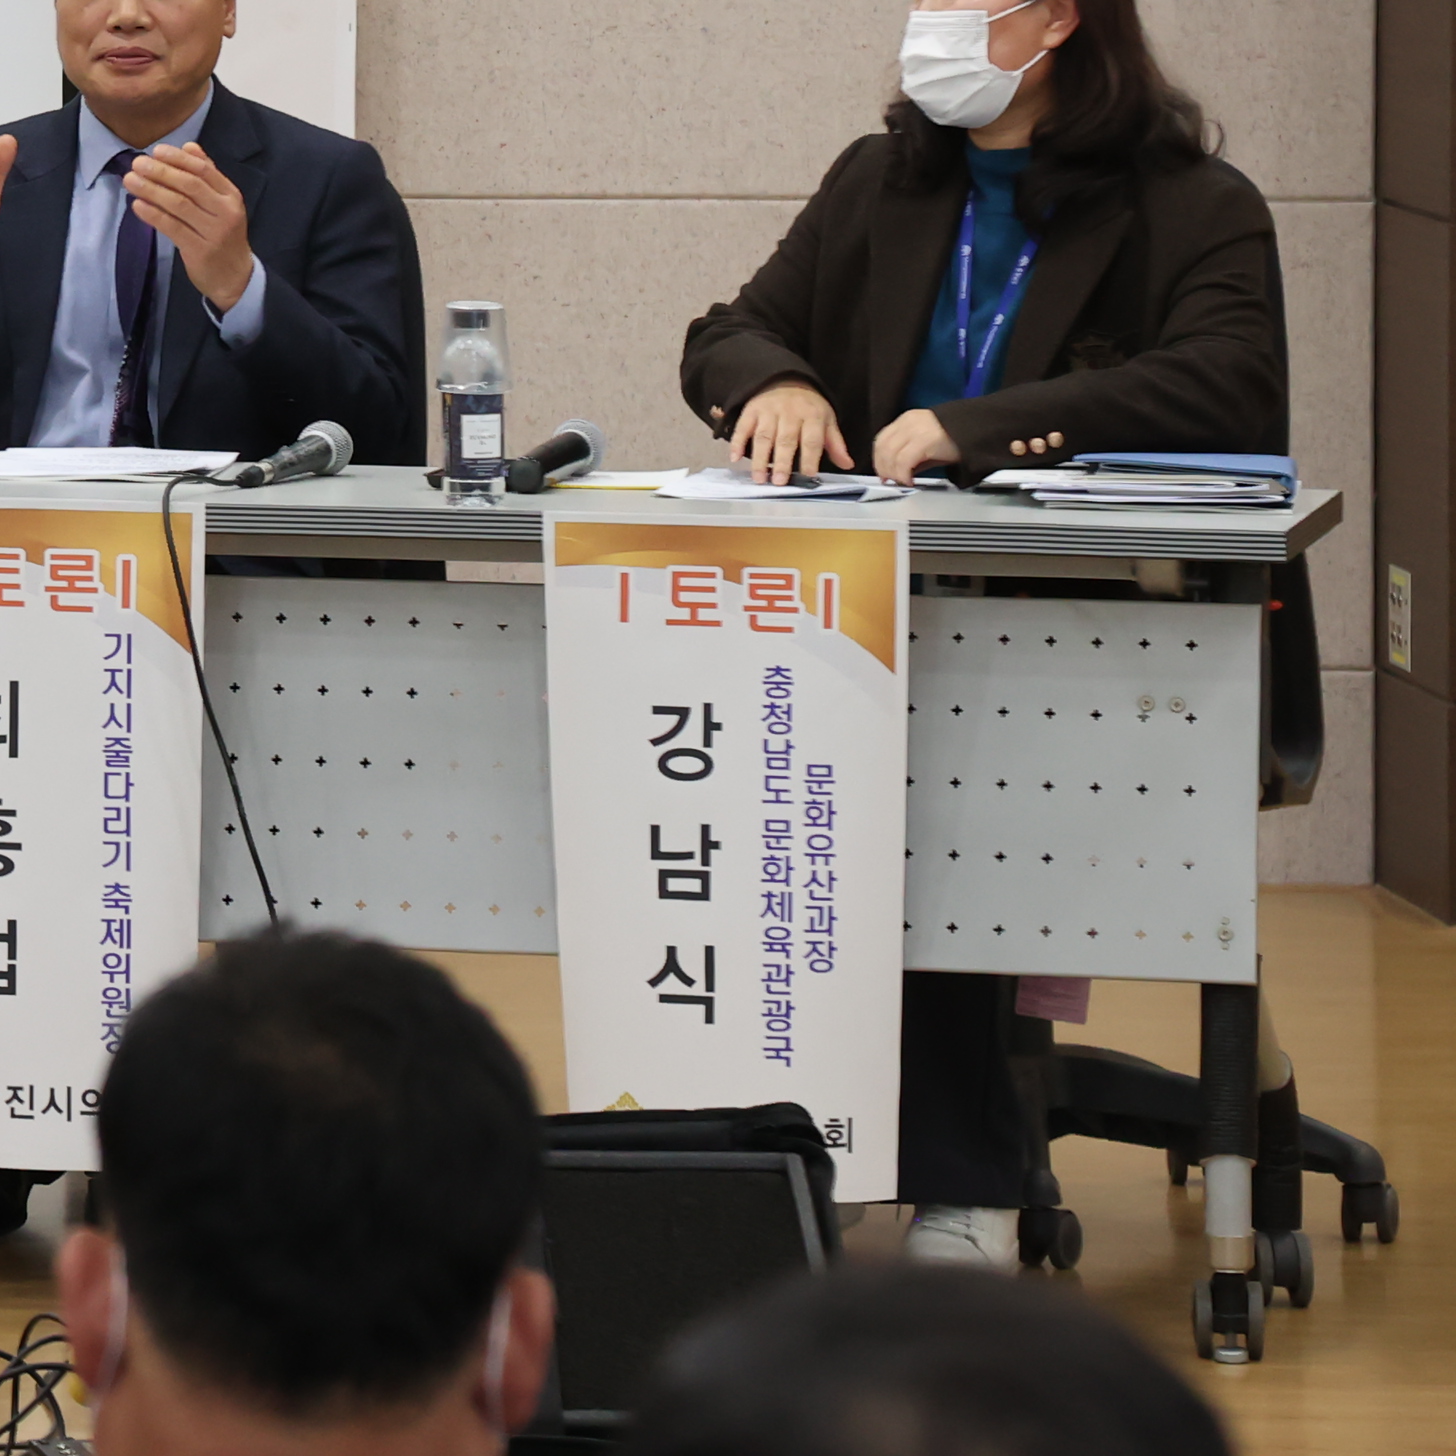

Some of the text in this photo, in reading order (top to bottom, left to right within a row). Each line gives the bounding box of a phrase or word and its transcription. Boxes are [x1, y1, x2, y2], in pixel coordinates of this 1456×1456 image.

[665, 571, 800, 634] 토론
[102, 633, 135, 872] 기지시줄다리기
[761, 665, 796, 1067] 충청남도 문화체육관광국
[803, 764, 838, 973] 문화유산과장
